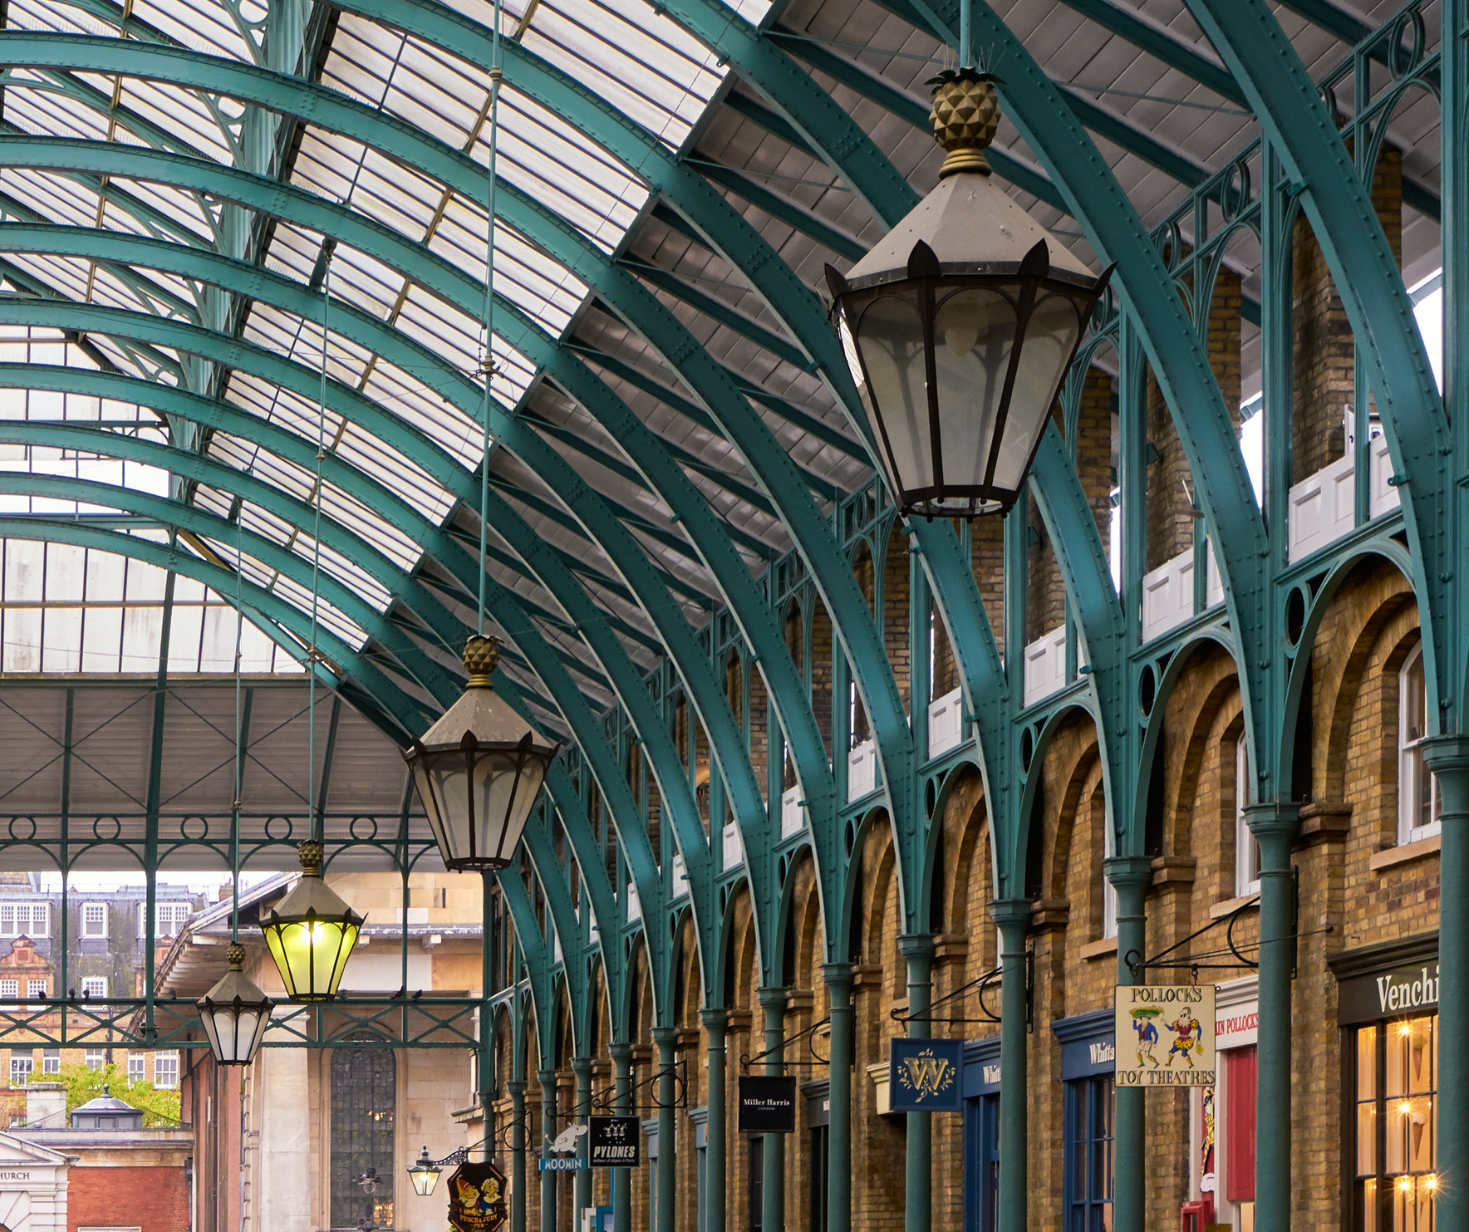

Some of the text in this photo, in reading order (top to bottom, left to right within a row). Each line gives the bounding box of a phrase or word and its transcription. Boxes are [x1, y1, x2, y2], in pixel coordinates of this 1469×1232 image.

[1376, 964, 1439, 1013] Venchi
[1089, 1042, 1115, 1065] Whitta
[903, 1057, 949, 1090] W
[983, 1064, 1001, 1085] Whitt
[1118, 1070, 1215, 1085] TOY THEATRES
[743, 1098, 790, 1106] Miller Harris
[593, 1146, 636, 1158] PYLONES
[544, 1159, 582, 1169] MOOMIN
[460, 1214, 479, 1223] PUNCH
[483, 1214, 498, 1223] JUDY
